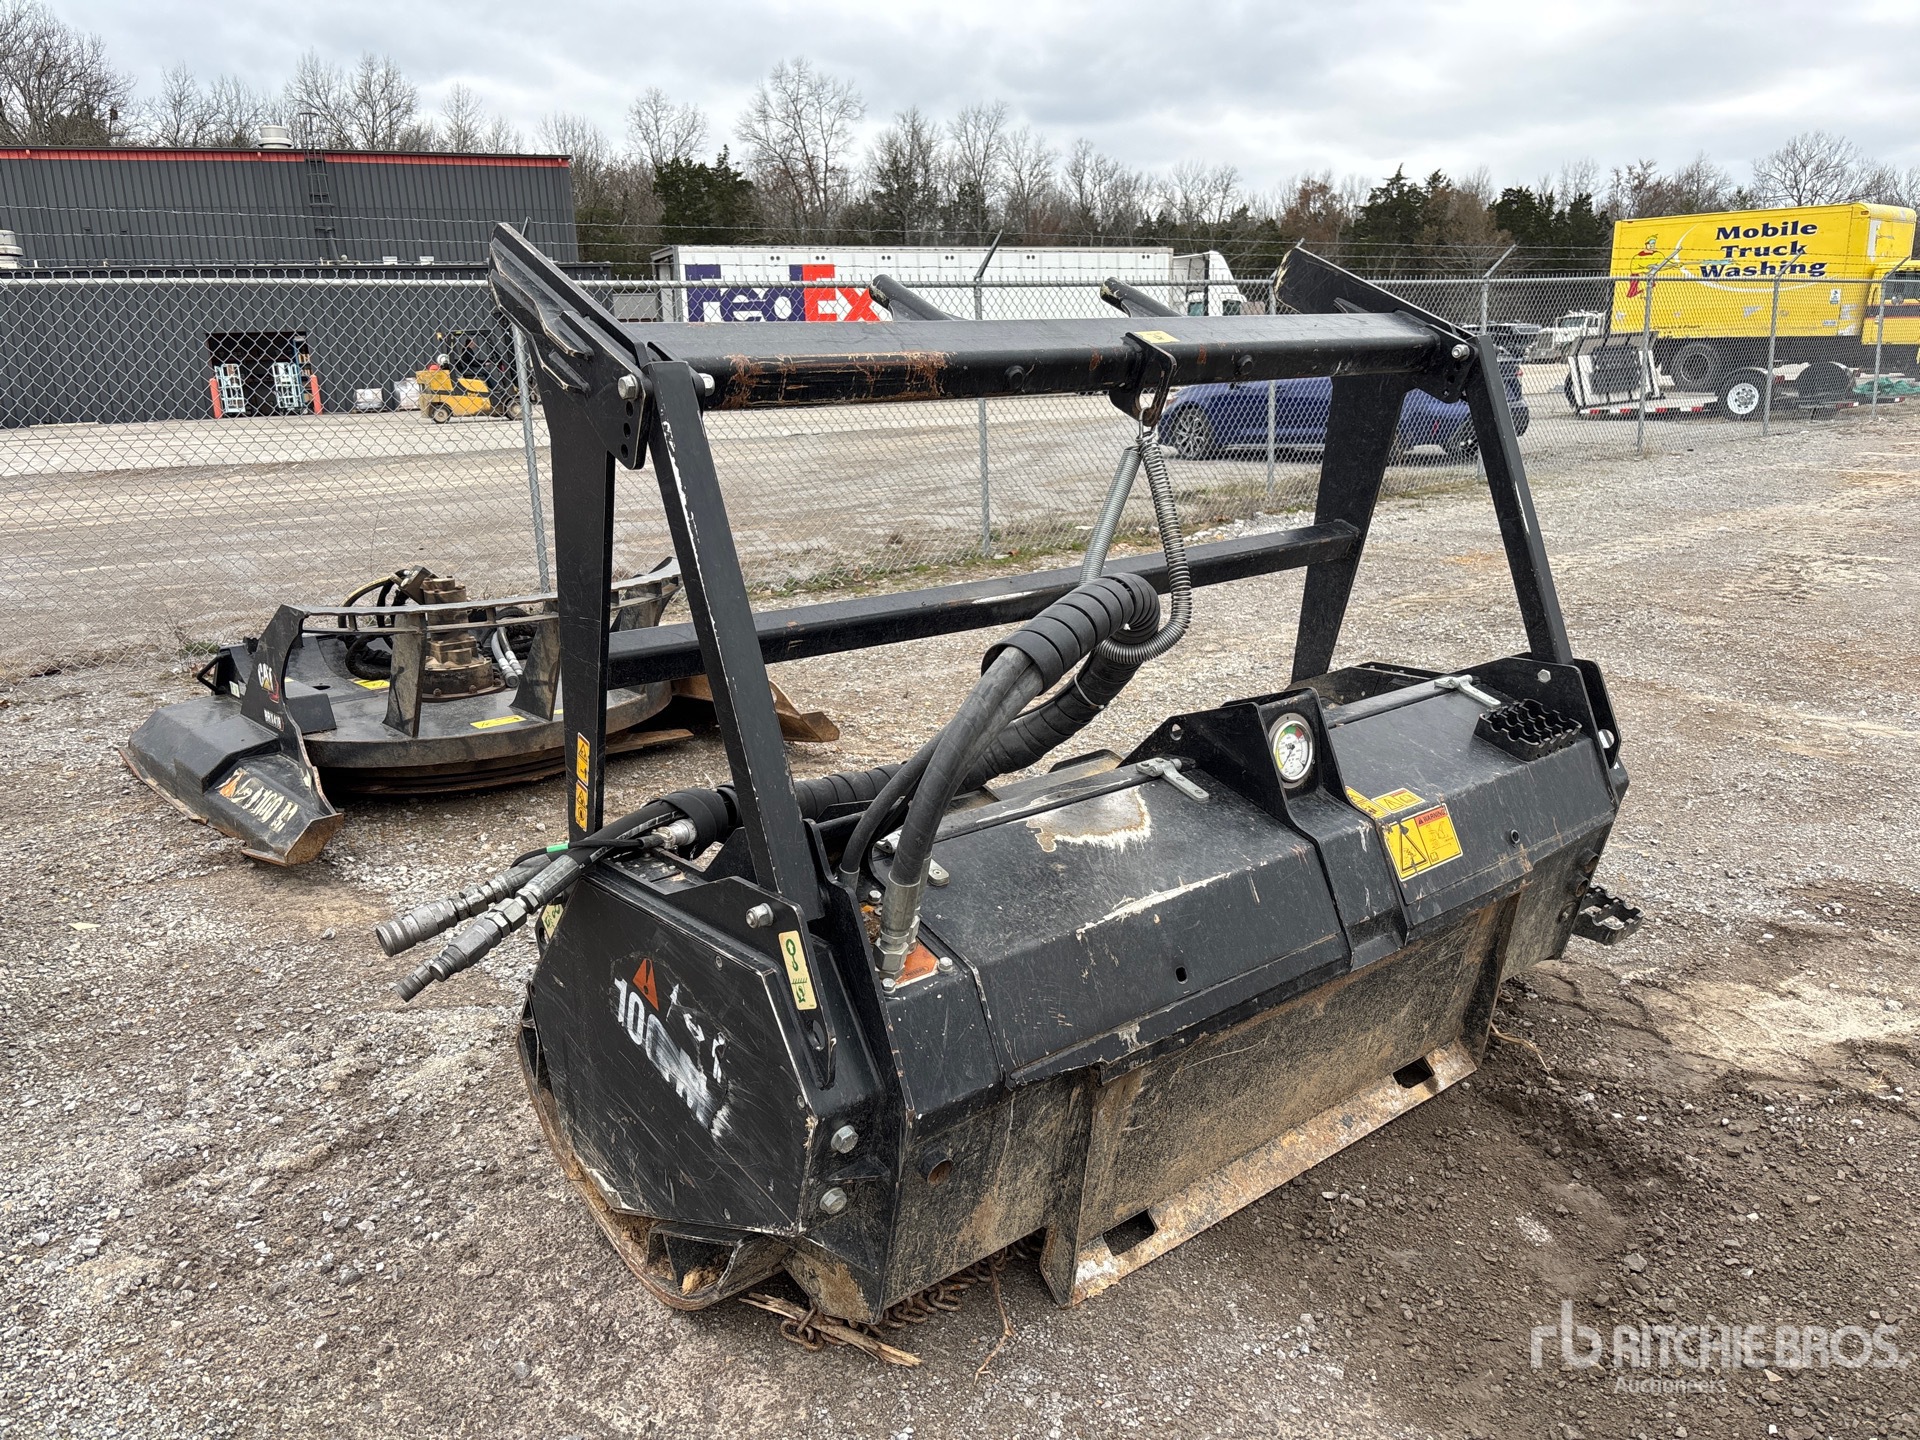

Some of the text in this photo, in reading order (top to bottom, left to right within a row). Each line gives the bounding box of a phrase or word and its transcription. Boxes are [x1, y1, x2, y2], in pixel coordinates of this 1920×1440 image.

[1715, 220, 1817, 240] Mobile
[1720, 240, 1807, 258] Truck
[1699, 260, 1827, 277] Washing
[685, 264, 880, 322] FedEx
[1423, 810, 1446, 822] WARNING
